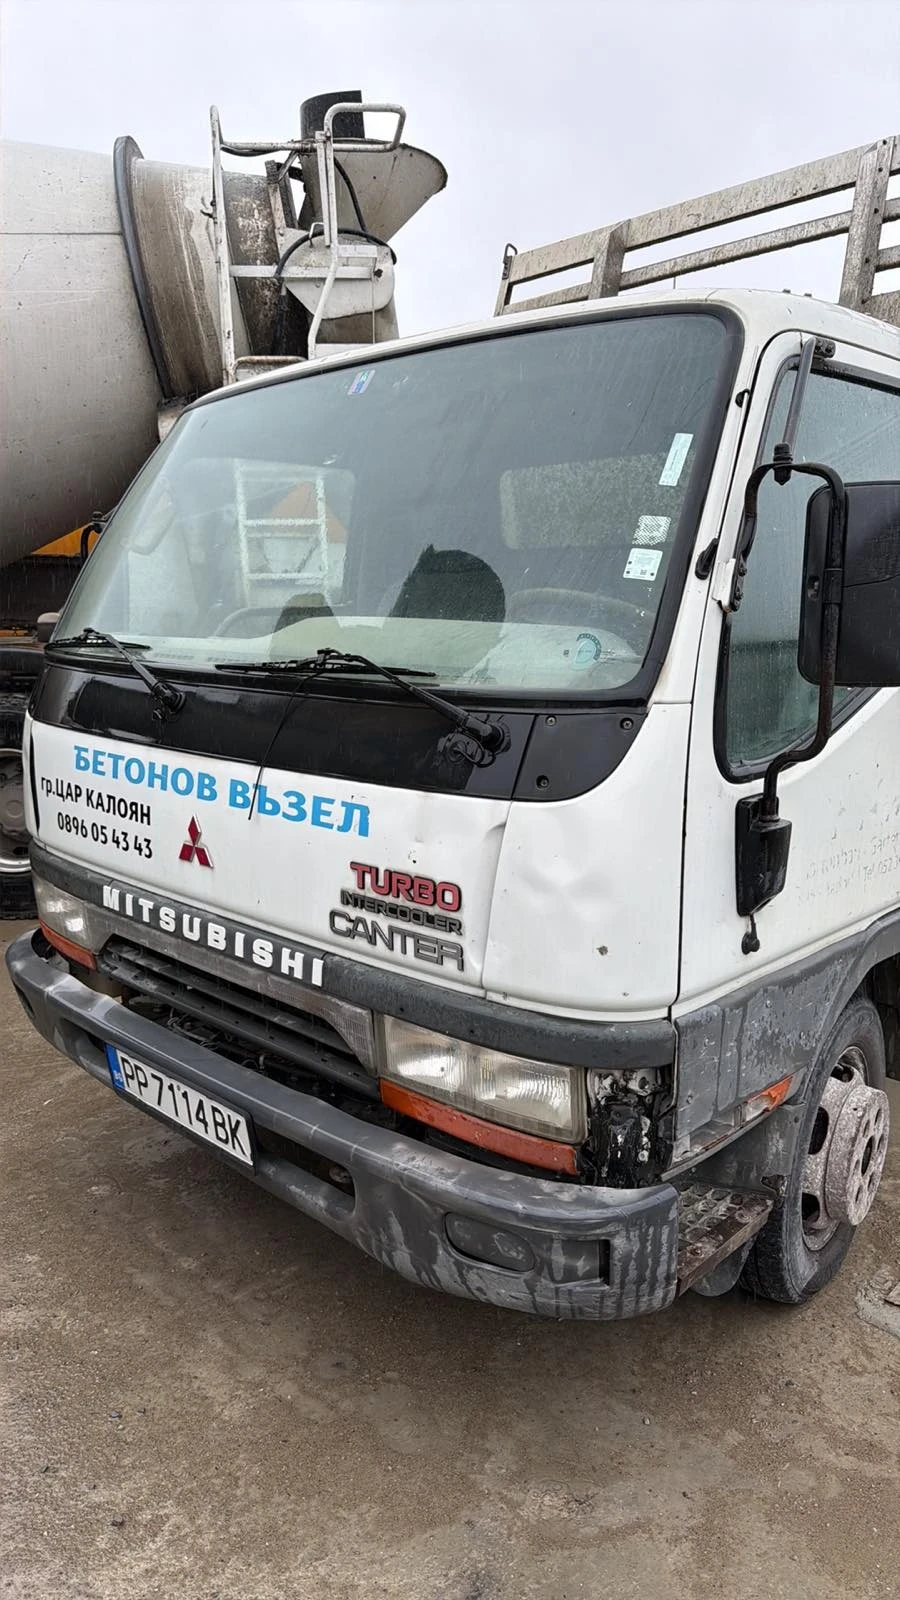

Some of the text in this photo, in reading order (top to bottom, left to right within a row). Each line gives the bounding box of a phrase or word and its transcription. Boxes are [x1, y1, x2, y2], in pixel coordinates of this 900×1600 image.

[73, 745, 370, 838] БЕТОНОВ ВЪЗЕЛ
[86, 787, 151, 826] КАЛОЯН
[57, 811, 153, 859] 0896 05 43 43
[350, 861, 462, 912] TURBO
[102, 885, 324, 988] MITSUBISHI
[340, 889, 463, 936] INTERCOOLER
[329, 909, 464, 972] CANTER
